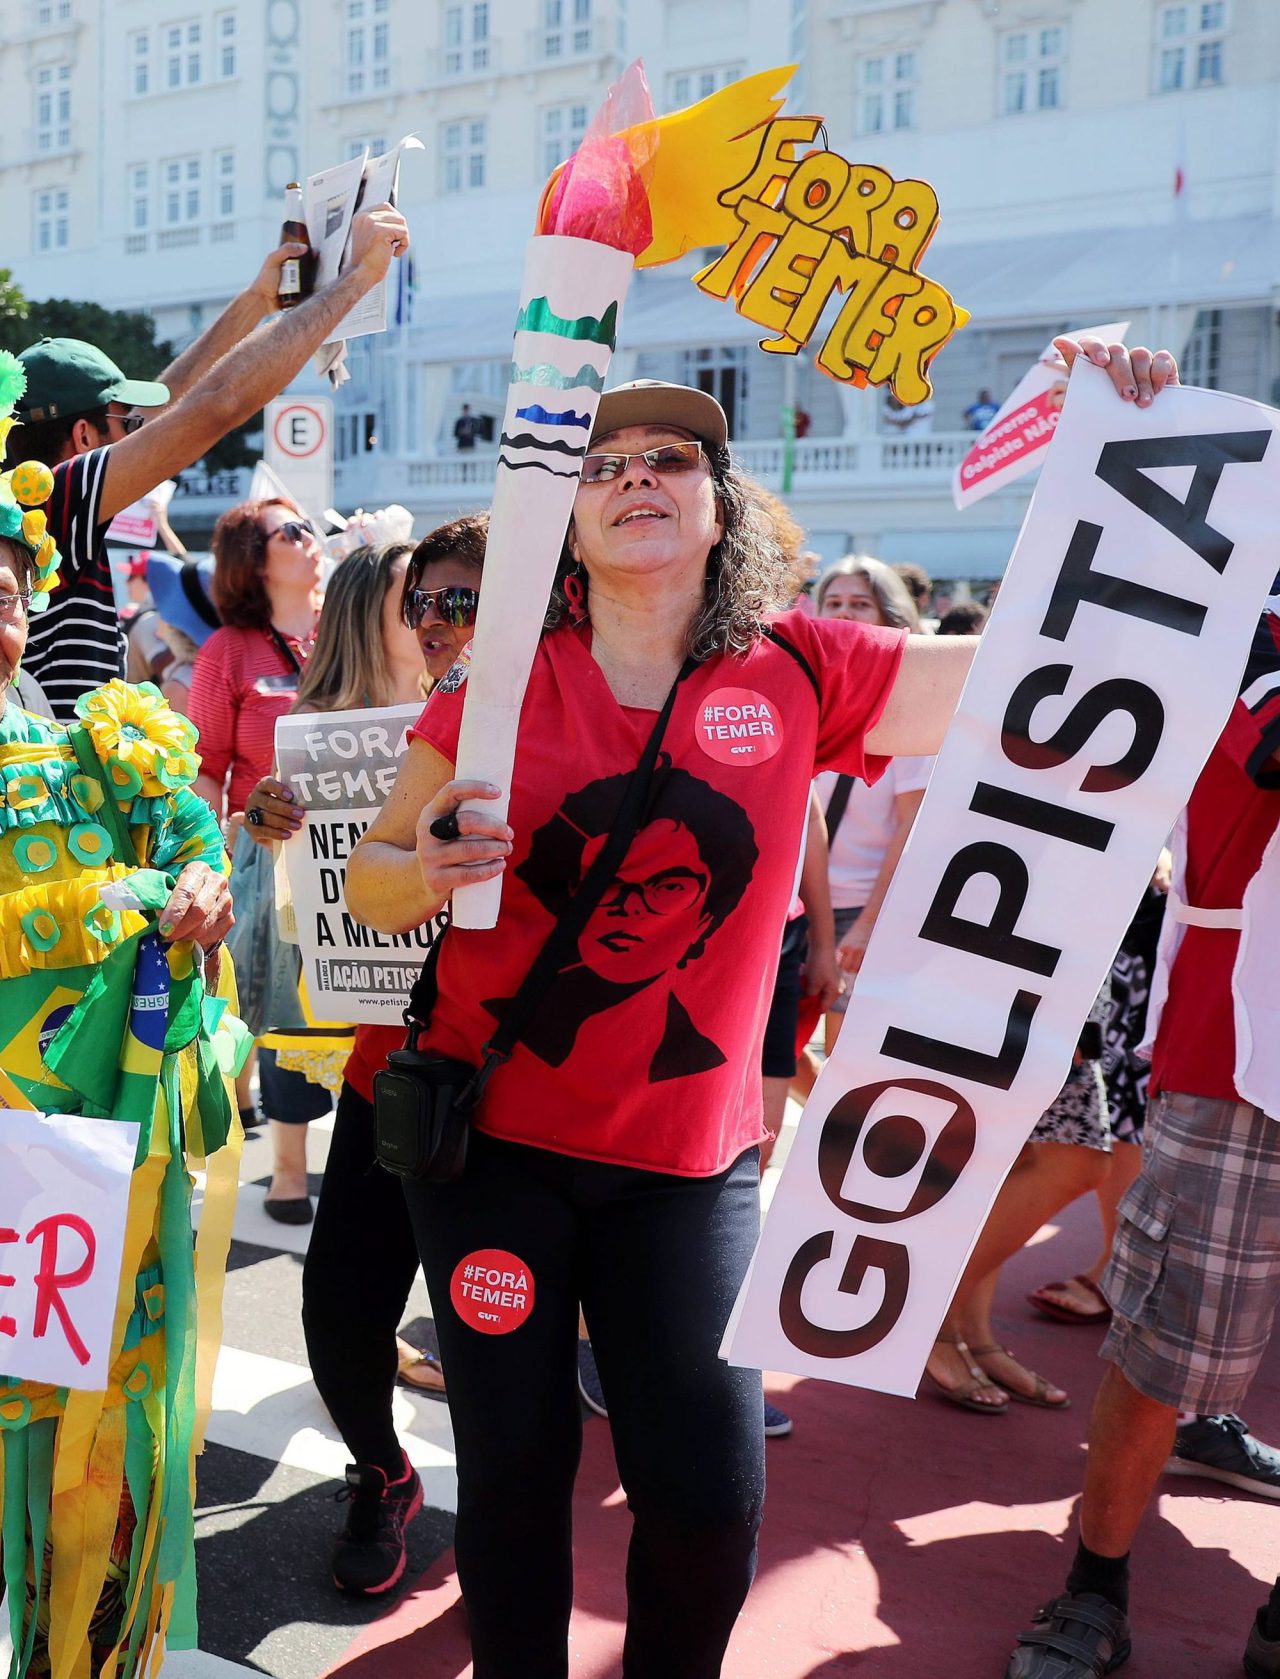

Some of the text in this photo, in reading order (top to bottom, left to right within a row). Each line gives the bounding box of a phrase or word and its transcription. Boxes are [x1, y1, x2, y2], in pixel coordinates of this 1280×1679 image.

[717, 117, 940, 275] FORA
[696, 195, 958, 406] TEMER
[292, 418, 307, 445] E
[963, 437, 1025, 479] Golpista
[703, 703, 772, 722] #FORA
[703, 721, 775, 740] TEMER
[730, 745, 753, 754] CUT
[779, 430, 1273, 1360] GOLPISTA
[317, 912, 336, 948] A
[333, 962, 371, 992] AÇÃO
[463, 1264, 528, 1291] #FORA
[460, 1281, 527, 1310] TEMER
[477, 1311, 499, 1322] CUT
